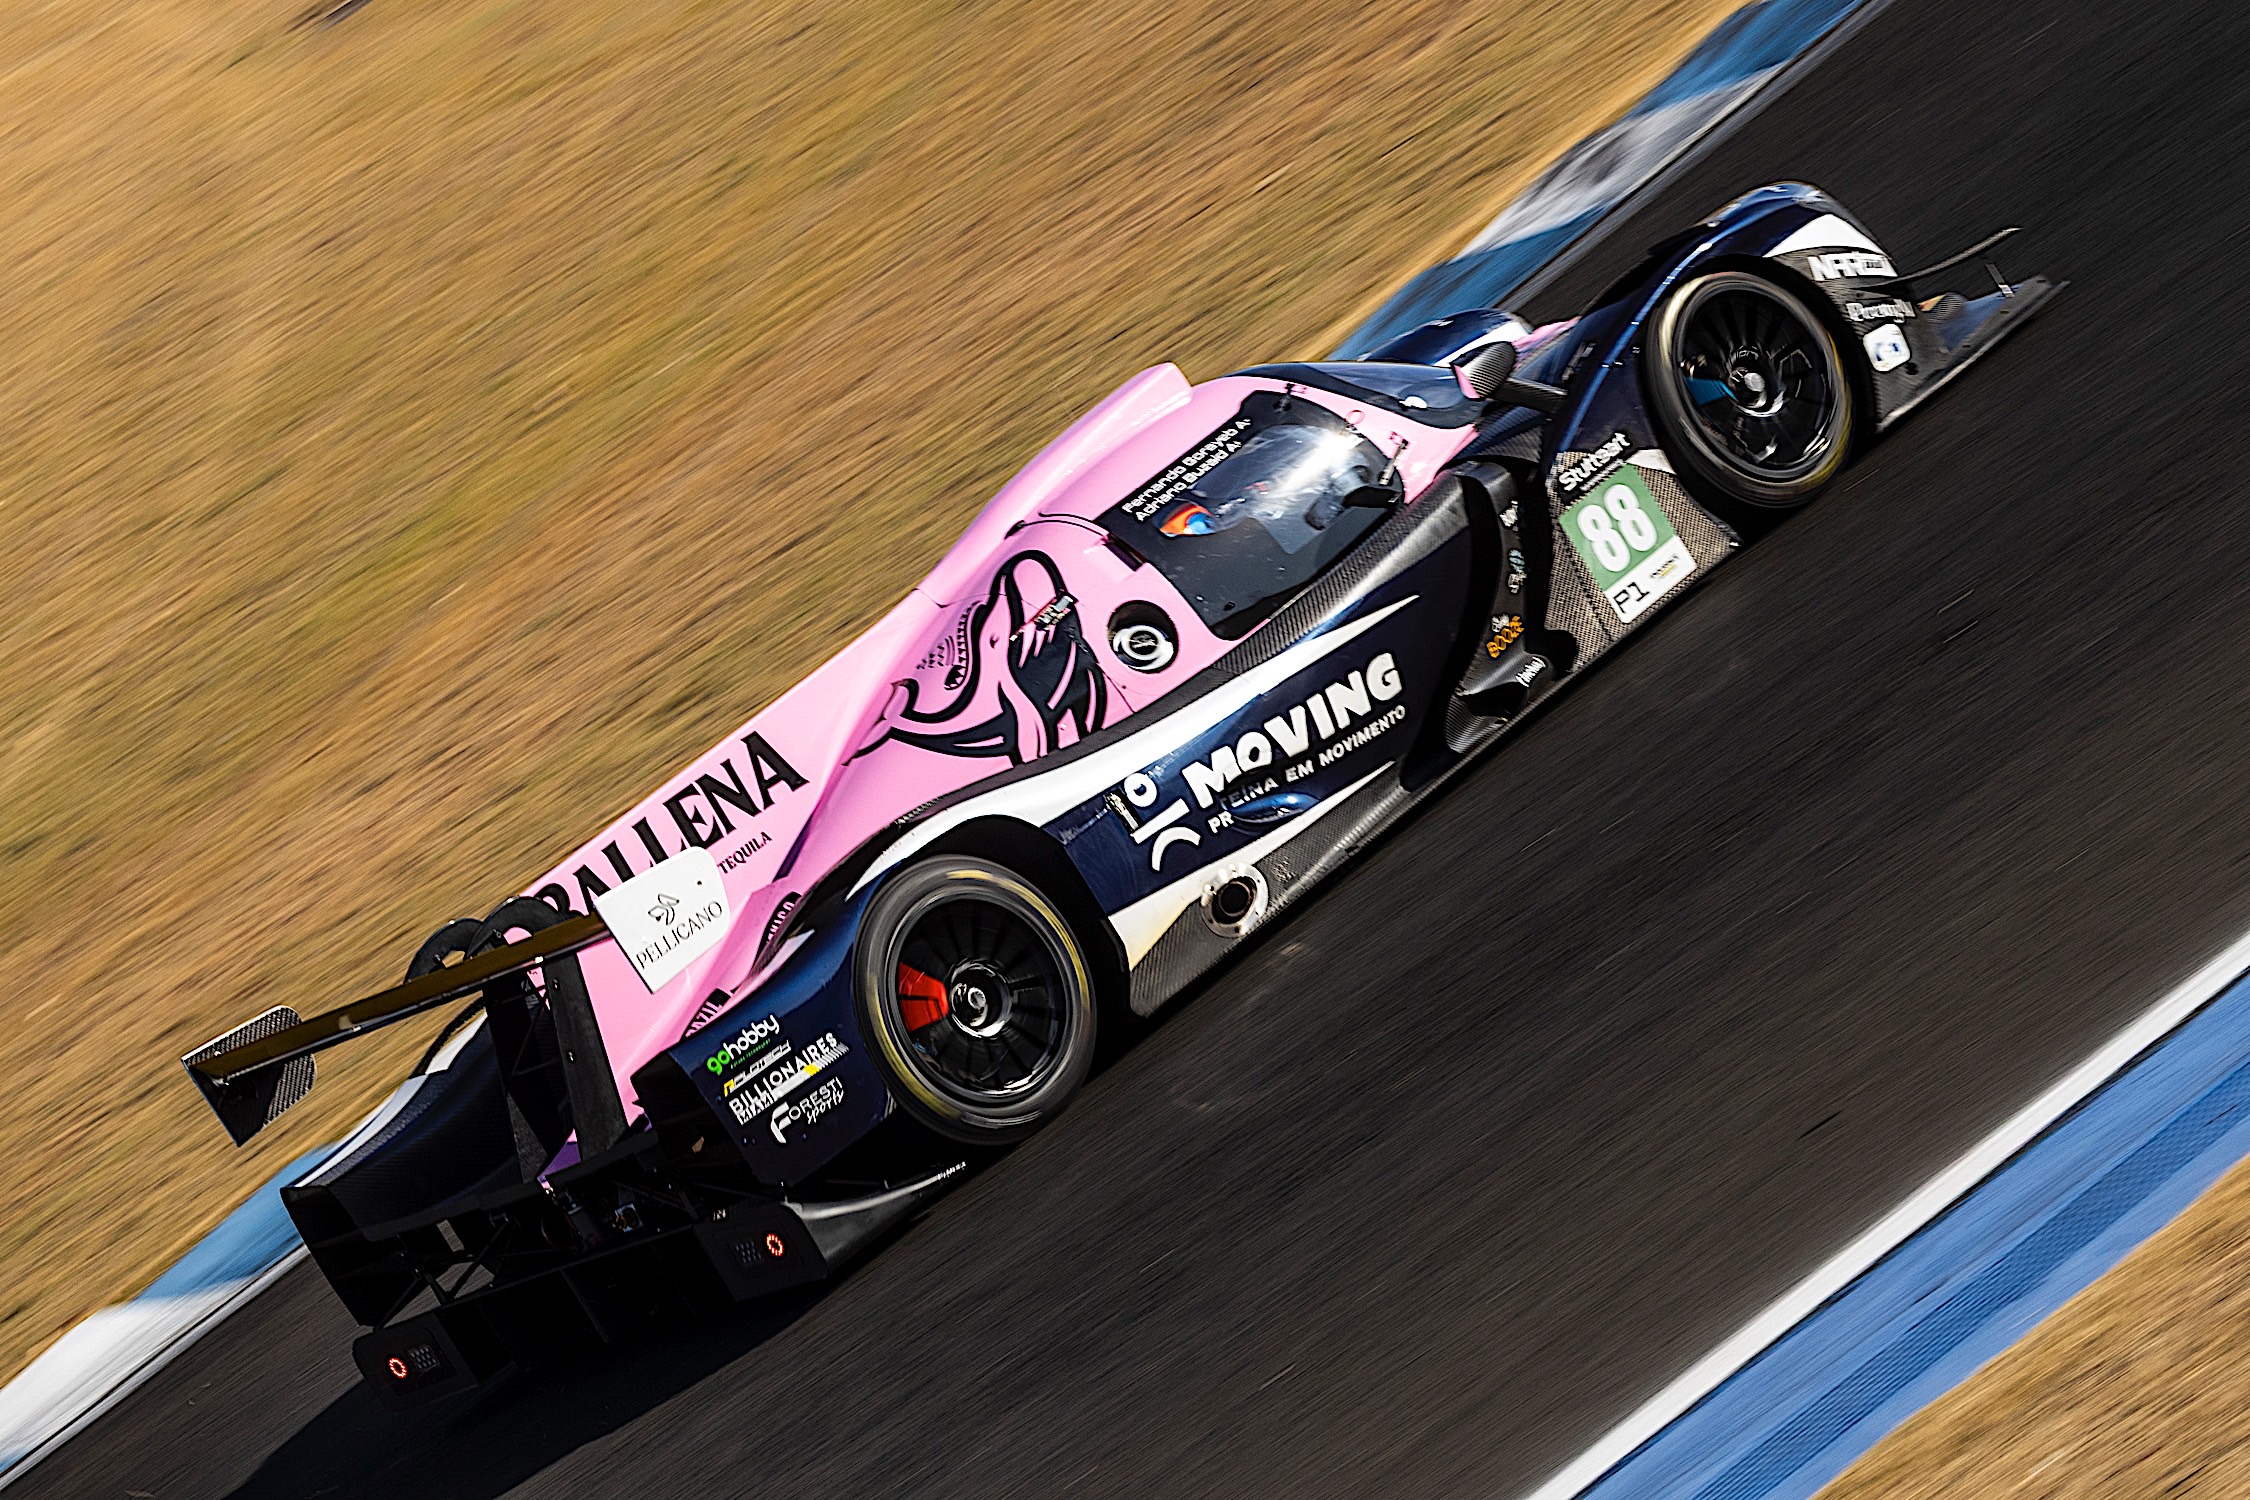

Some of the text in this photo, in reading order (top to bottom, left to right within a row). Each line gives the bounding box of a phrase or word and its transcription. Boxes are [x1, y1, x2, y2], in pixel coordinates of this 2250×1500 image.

[1122, 465, 1187, 513] Fernando
[1135, 481, 1187, 521] Adriano
[1181, 449, 1229, 484] Buzaid
[1577, 484, 1658, 572] 88
[1613, 581, 1650, 613] P1
[1182, 653, 1402, 808] MOVING
[1285, 759, 1315, 783] EM
[1319, 704, 1406, 766] MOVIMENTO
[717, 831, 773, 874] TEQUILA
[636, 900, 723, 969] PELLICANO
[707, 1014, 780, 1076] gohobby
[729, 1032, 838, 1115] BILLIONAIRES
[770, 1076, 843, 1144] FORESTI
